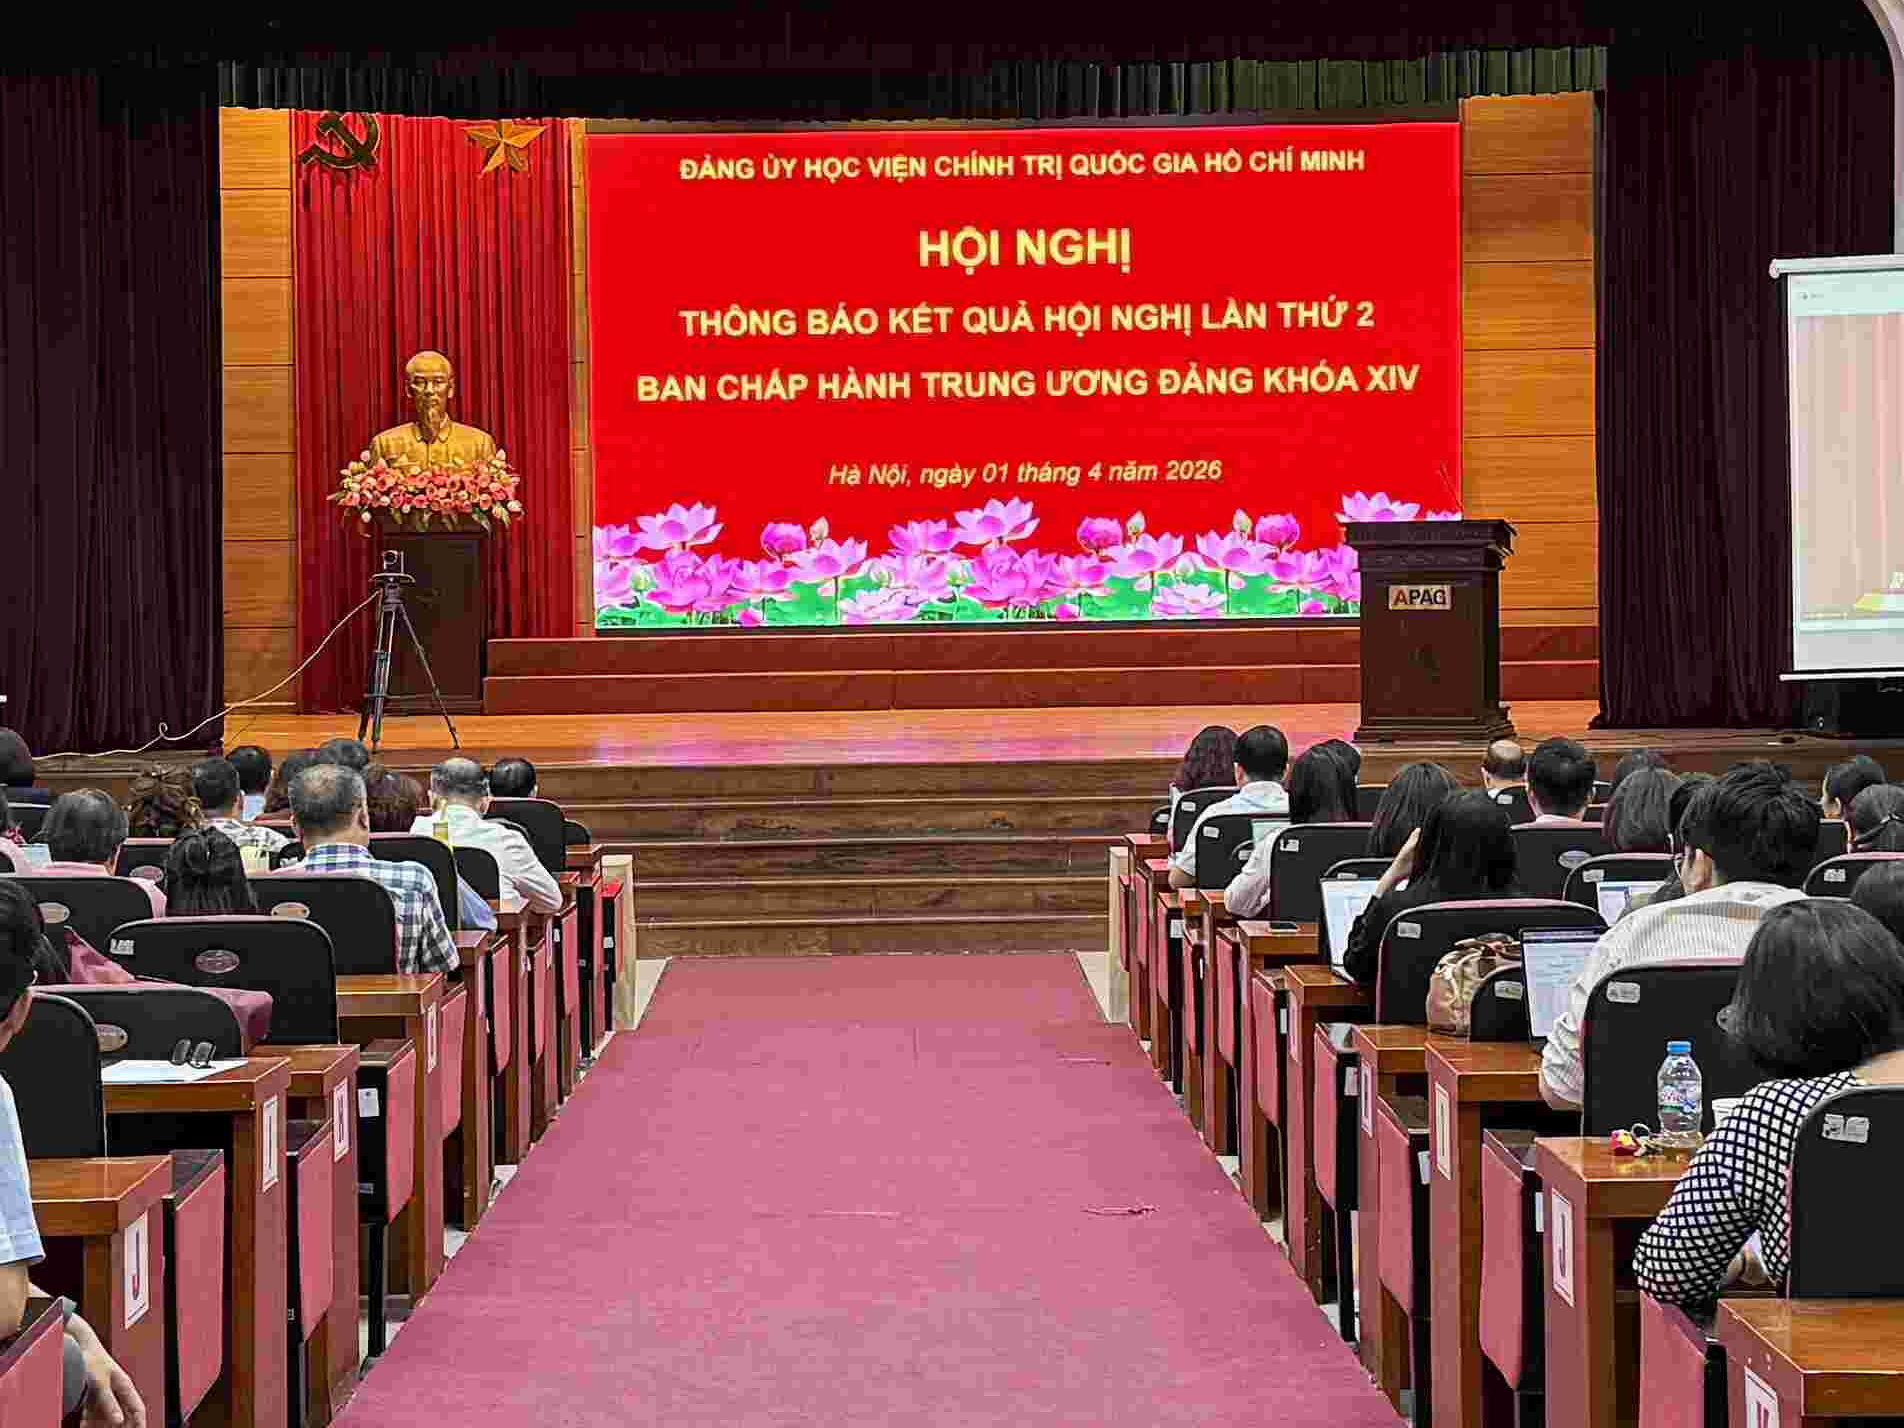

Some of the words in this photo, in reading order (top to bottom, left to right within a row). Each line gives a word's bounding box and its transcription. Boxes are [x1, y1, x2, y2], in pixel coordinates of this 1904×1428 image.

[679, 154, 755, 180] ĐẢNG
[762, 153, 797, 180] ỦY
[804, 156, 860, 183] HỌC
[867, 154, 927, 183] VIỆN
[934, 150, 1014, 177] CHÍNH
[1022, 154, 1063, 181] TRỊ
[1069, 149, 1145, 176] QUỐC
[1152, 152, 1199, 174] GIA
[1204, 147, 1243, 173] HỒ
[1248, 145, 1293, 173] CHÍ
[1300, 150, 1365, 172] MINH
[919, 225, 1000, 276] HỘI
[1016, 227, 1132, 274] NGHỊ
[679, 303, 797, 337] THÔNG
[807, 302, 879, 335] BÁO
[888, 301, 954, 334] KẾT
[962, 299, 1035, 335] QUẢ
[1044, 301, 1101, 338] HỘI
[1111, 303, 1192, 337] NGHỊ
[1201, 297, 1267, 330] LẦN
[1277, 294, 1349, 328] THỨ
[1356, 300, 1375, 327] 2
[637, 374, 706, 402] BAN
[716, 368, 809, 401] CHẤP
[818, 366, 911, 400] HÀNH
[921, 370, 1036, 399] TRUNG
[1046, 368, 1148, 397] ƯƠNG
[1157, 361, 1254, 395] ĐẢNG
[1263, 359, 1359, 393] KHÓA
[1365, 364, 1420, 392] XIV
[828, 463, 861, 485] Hà
[868, 463, 911, 488] Nội,
[919, 464, 977, 489] ngày
[982, 462, 1009, 483] 01
[1017, 460, 1081, 486] tháng
[1087, 462, 1102, 481] 4
[1108, 460, 1158, 482] năm
[1165, 459, 1224, 482] 2026
